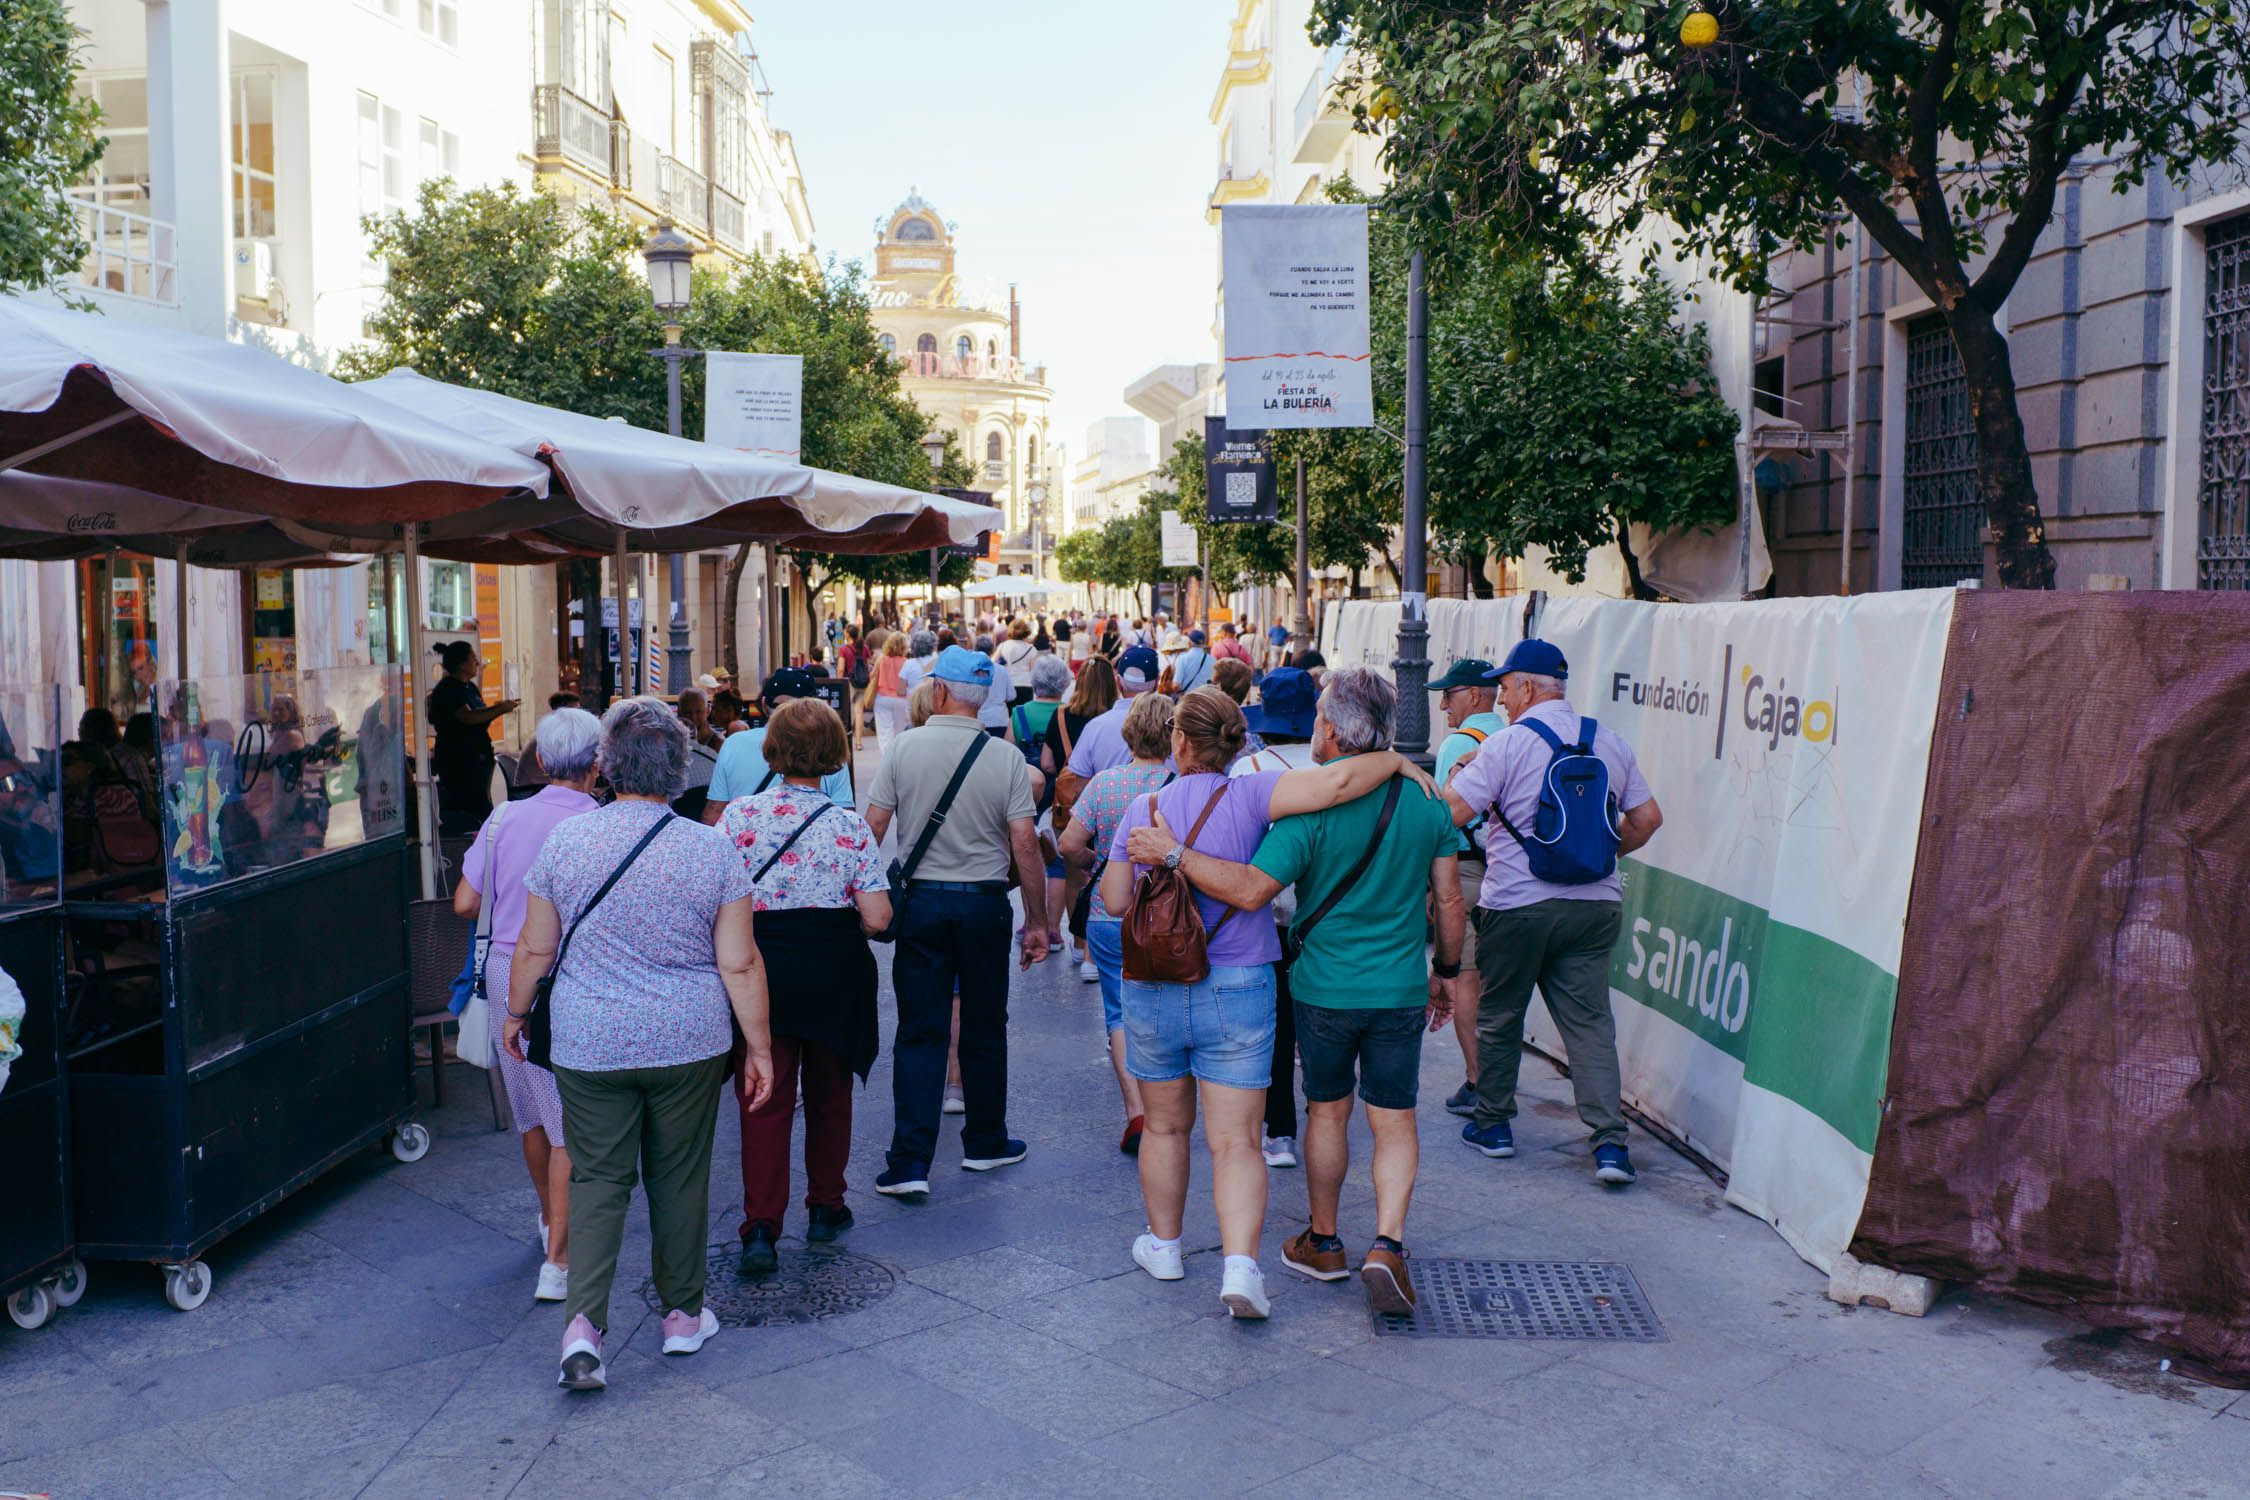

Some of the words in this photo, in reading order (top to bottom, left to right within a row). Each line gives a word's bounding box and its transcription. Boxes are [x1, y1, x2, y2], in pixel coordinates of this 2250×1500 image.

[1307, 387, 1317, 395] DE
[1263, 398, 1278, 409] LA
[1283, 394, 1331, 409] BULERÍA
[1225, 442, 1256, 451] Viernes
[1220, 451, 1262, 459] Flamenco
[67, 511, 117, 532] Coca-Cola
[1612, 671, 1709, 717] Fundación
[1743, 673, 1839, 752] Cajaol
[1626, 916, 1749, 1033] sando
